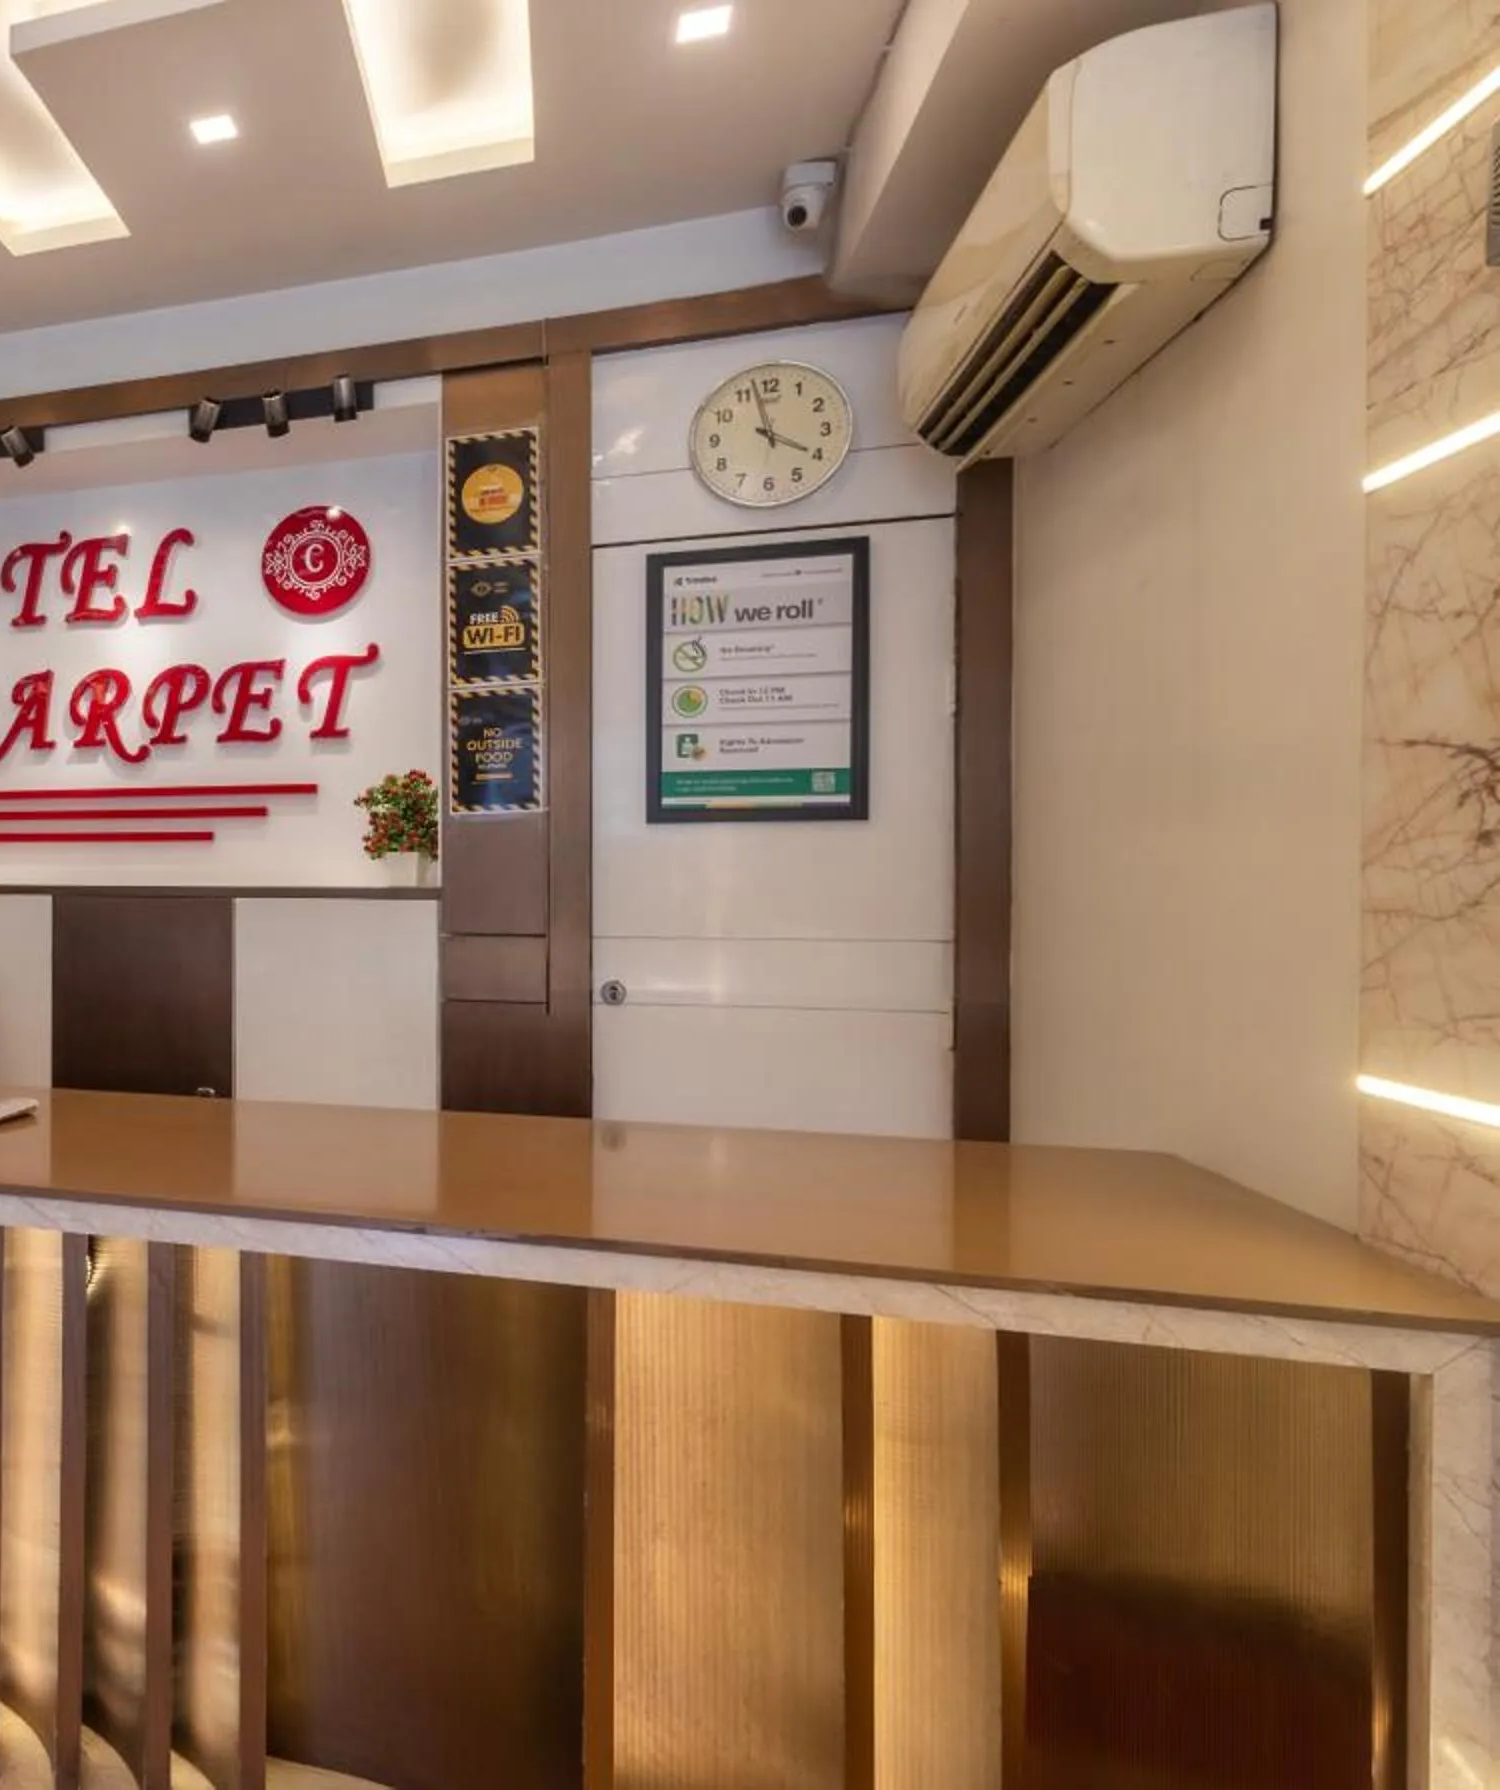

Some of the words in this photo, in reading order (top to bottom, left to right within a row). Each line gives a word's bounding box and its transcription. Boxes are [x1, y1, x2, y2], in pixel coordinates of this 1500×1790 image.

[762, 378, 779, 393] 12
[795, 382, 803, 396] 1
[735, 389, 751, 402] 11
[812, 397, 825, 413] 2
[715, 409, 733, 424] 10
[820, 422, 832, 437] 3
[709, 434, 721, 448] 9
[812, 448, 823, 461] 4
[716, 457, 727, 471] 8
[735, 473, 747, 488] 7
[791, 467, 803, 482] 5
[763, 477, 775, 491] 6
[672, 594, 729, 626] HOW
[734, 606, 771, 623] we
[469, 611, 499, 624] FREE
[466, 626, 520, 645] WI-FI
[483, 726, 502, 738] NO
[466, 738, 522, 751] OUTSIDE
[475, 751, 513, 764] FOOD
